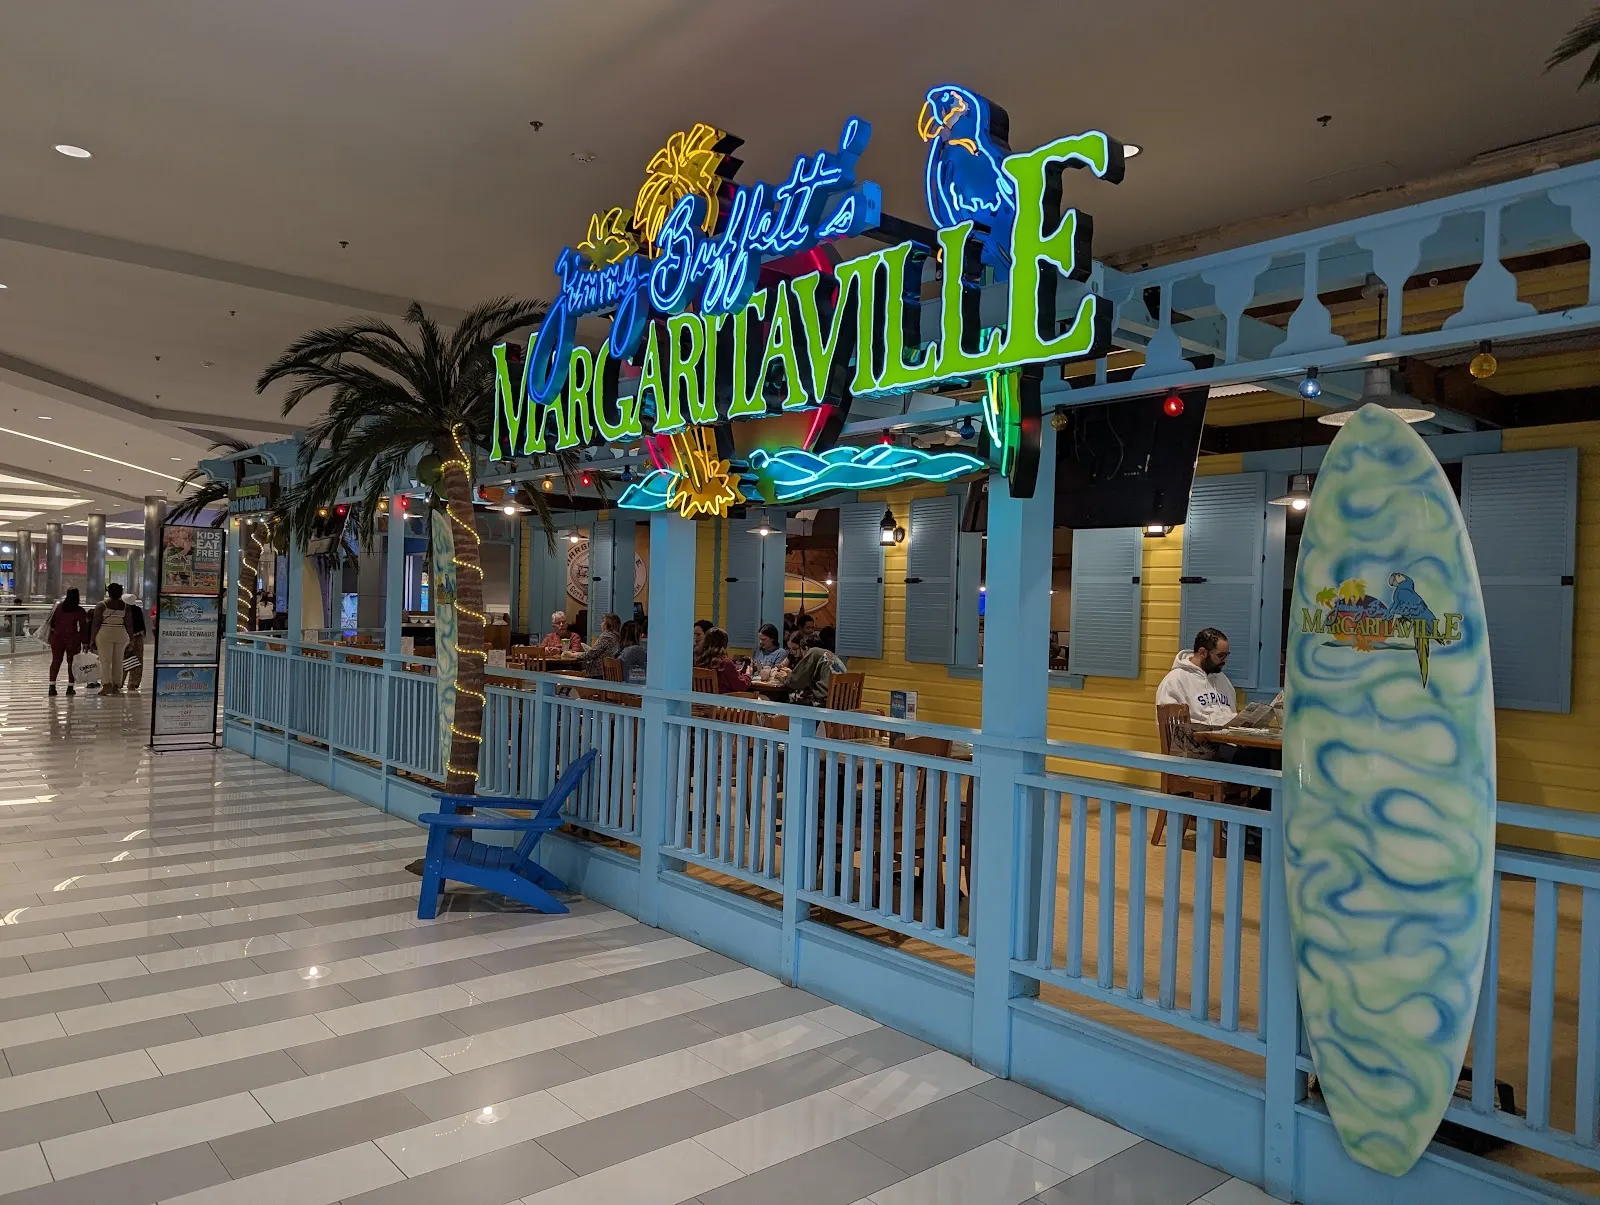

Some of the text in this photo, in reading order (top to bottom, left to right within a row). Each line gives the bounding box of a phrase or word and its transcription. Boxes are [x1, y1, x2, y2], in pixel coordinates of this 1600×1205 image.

[529, 117, 858, 403] Jimmy Buffett's
[490, 130, 1108, 462] MARGARITAVILLE
[196, 531, 220, 540] KIDS
[196, 539, 220, 550] EAT
[196, 549, 220, 558] FREE
[1302, 608, 1463, 640] MARGARITAVILLE
[189, 630, 215, 638] REWARDS
